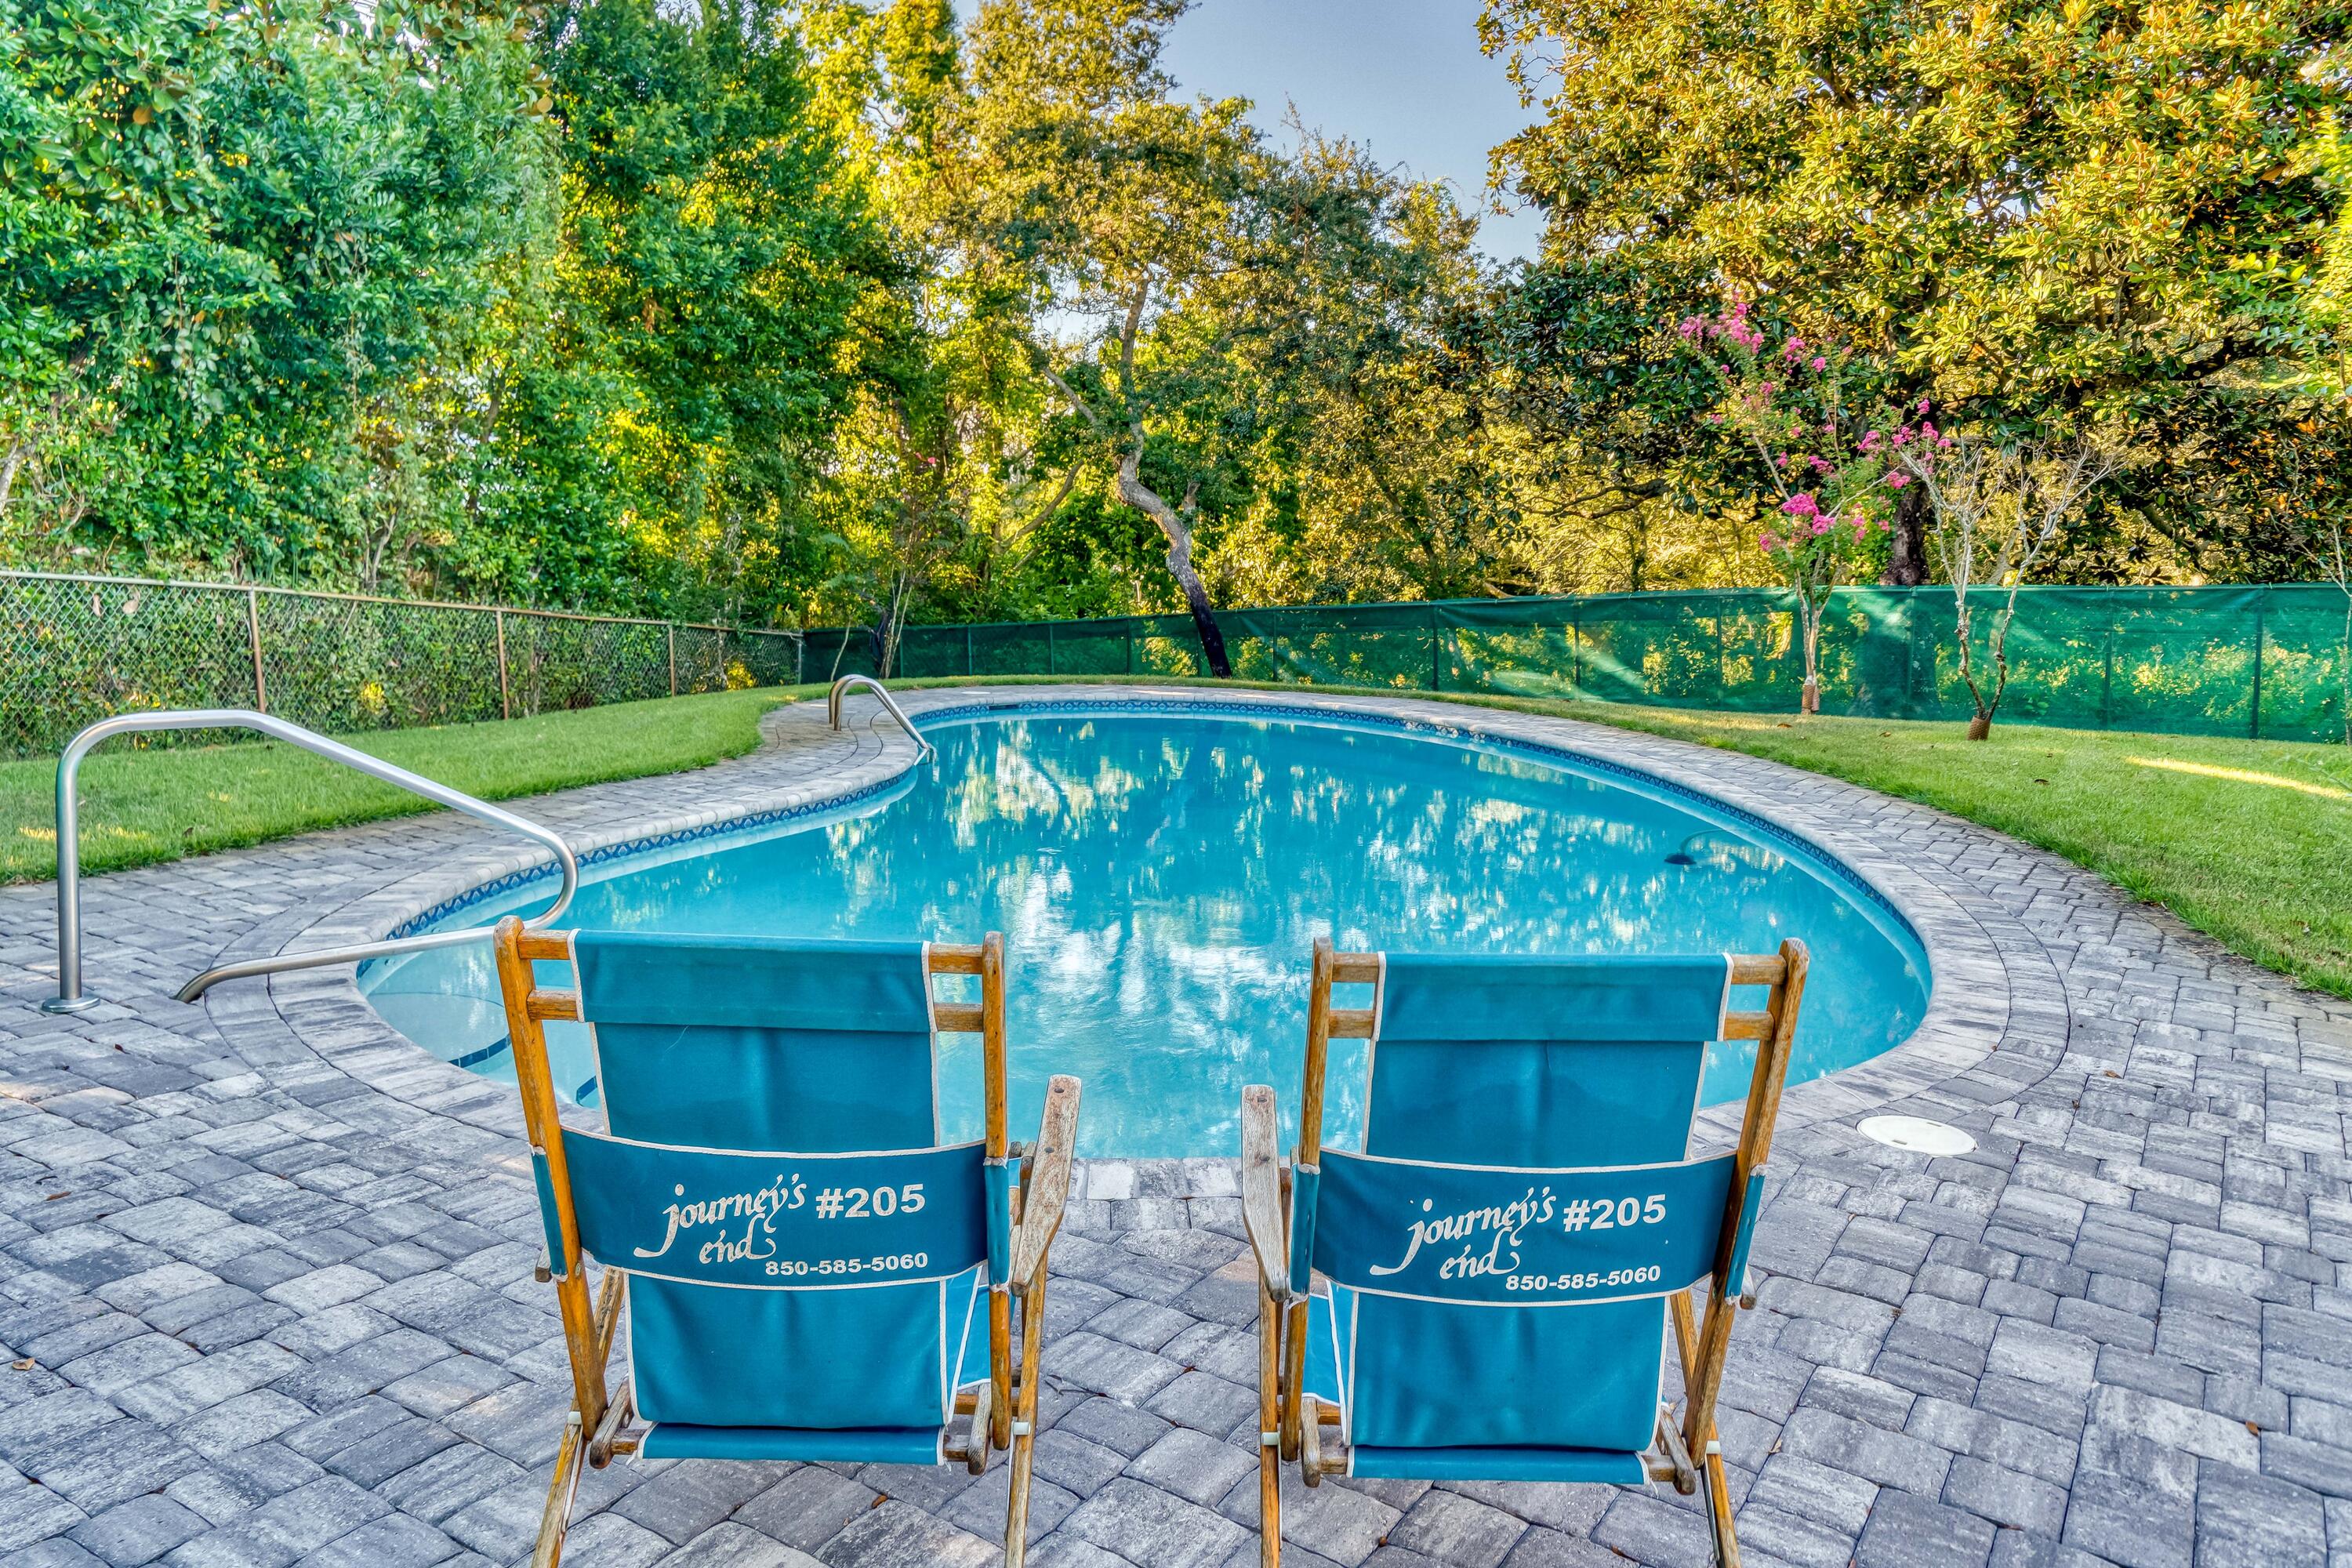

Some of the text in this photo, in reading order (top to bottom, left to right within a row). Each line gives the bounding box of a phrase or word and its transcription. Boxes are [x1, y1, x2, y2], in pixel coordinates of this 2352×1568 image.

[633, 1173, 926, 1258] journey's #205
[1369, 1186, 1667, 1276] journey's #205
[764, 1252, 928, 1276] 850-585-5060
[1505, 1265, 1661, 1290] 850-585-5060
